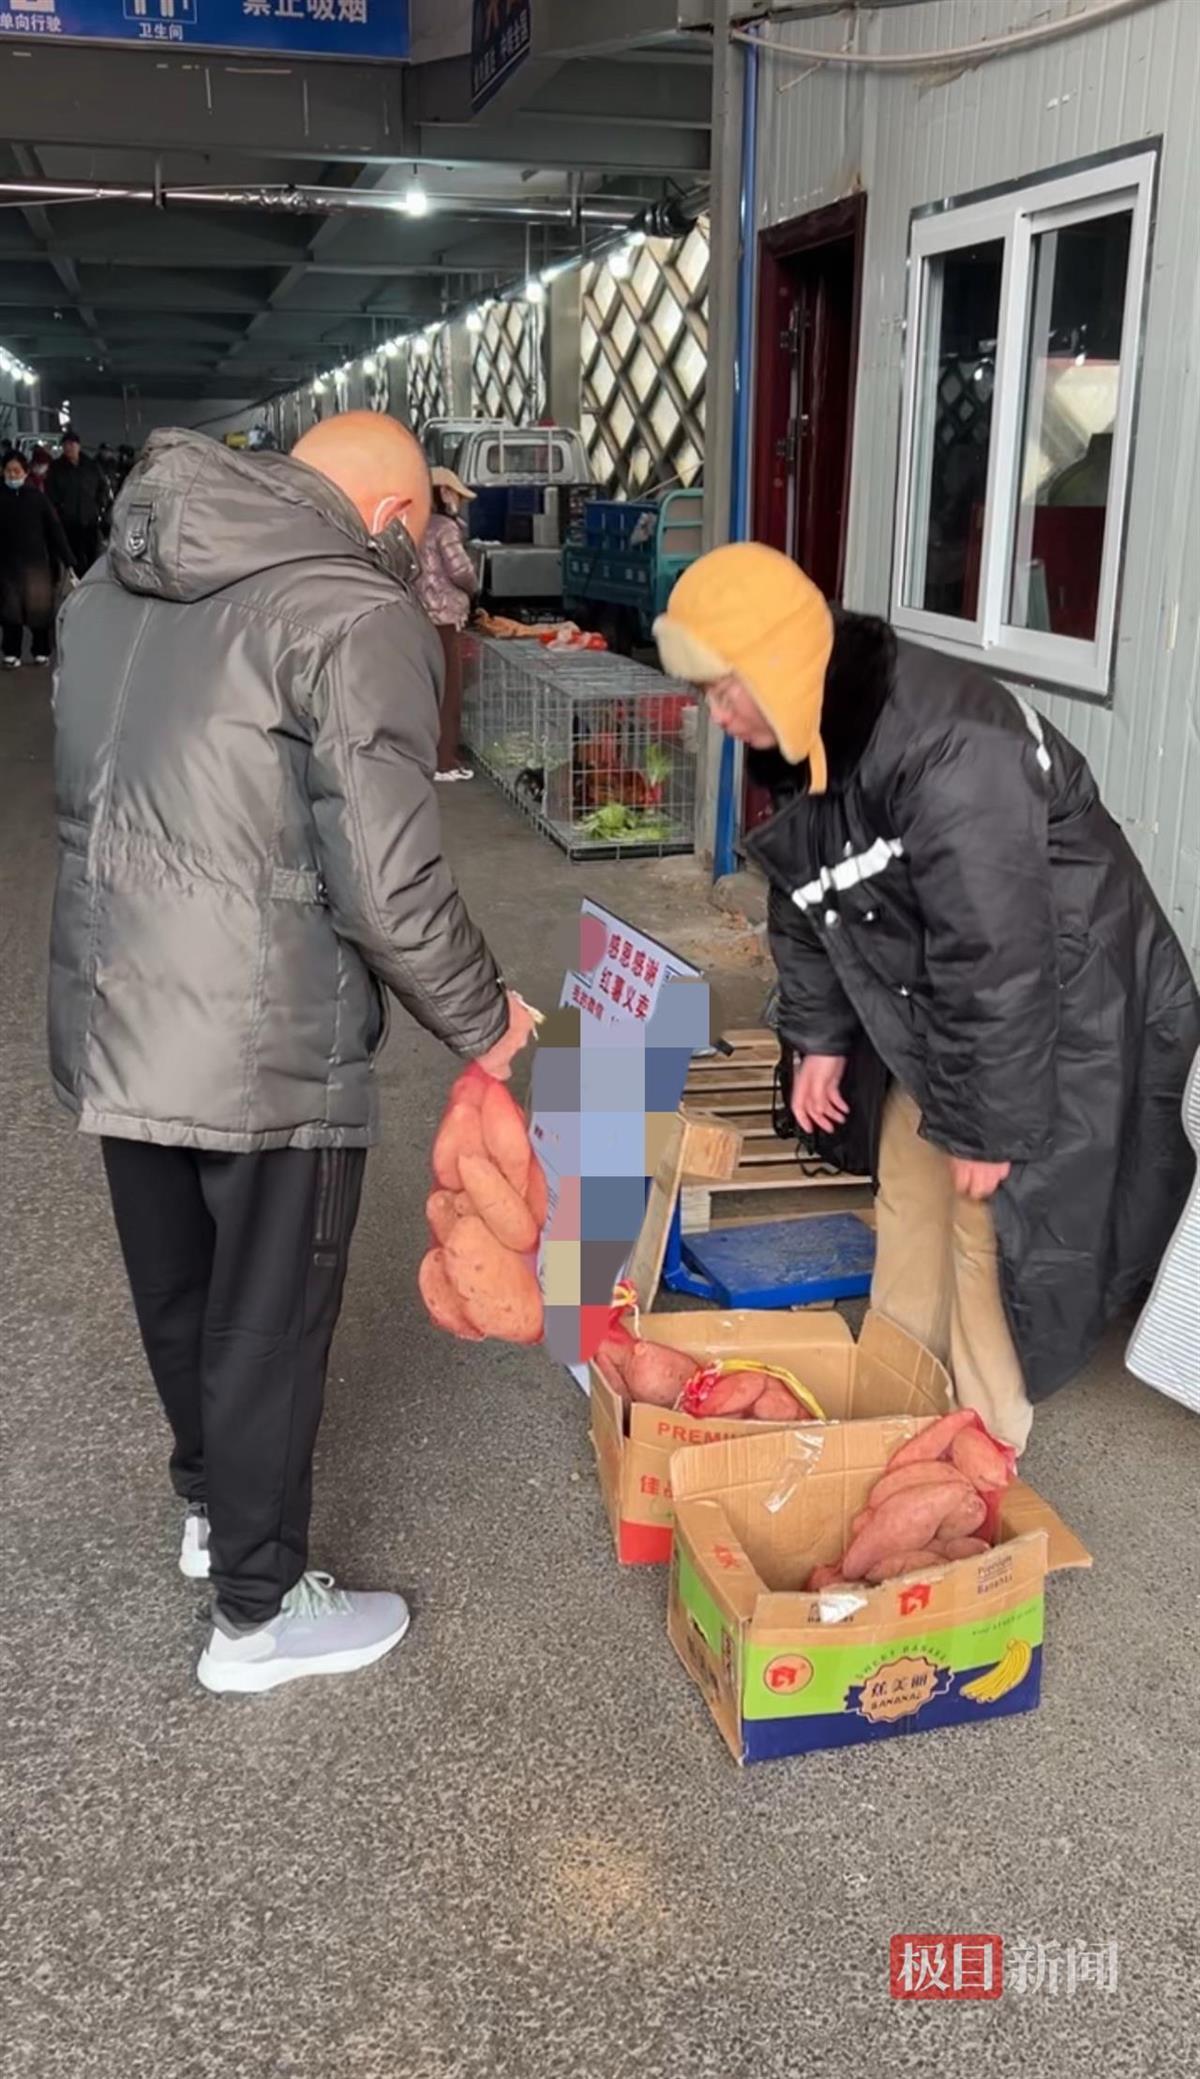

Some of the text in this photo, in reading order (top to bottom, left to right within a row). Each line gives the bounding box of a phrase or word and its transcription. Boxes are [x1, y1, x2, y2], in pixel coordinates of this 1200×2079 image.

[0, 13, 62, 32] 单向行驶
[139, 22, 183, 41] 卫生间
